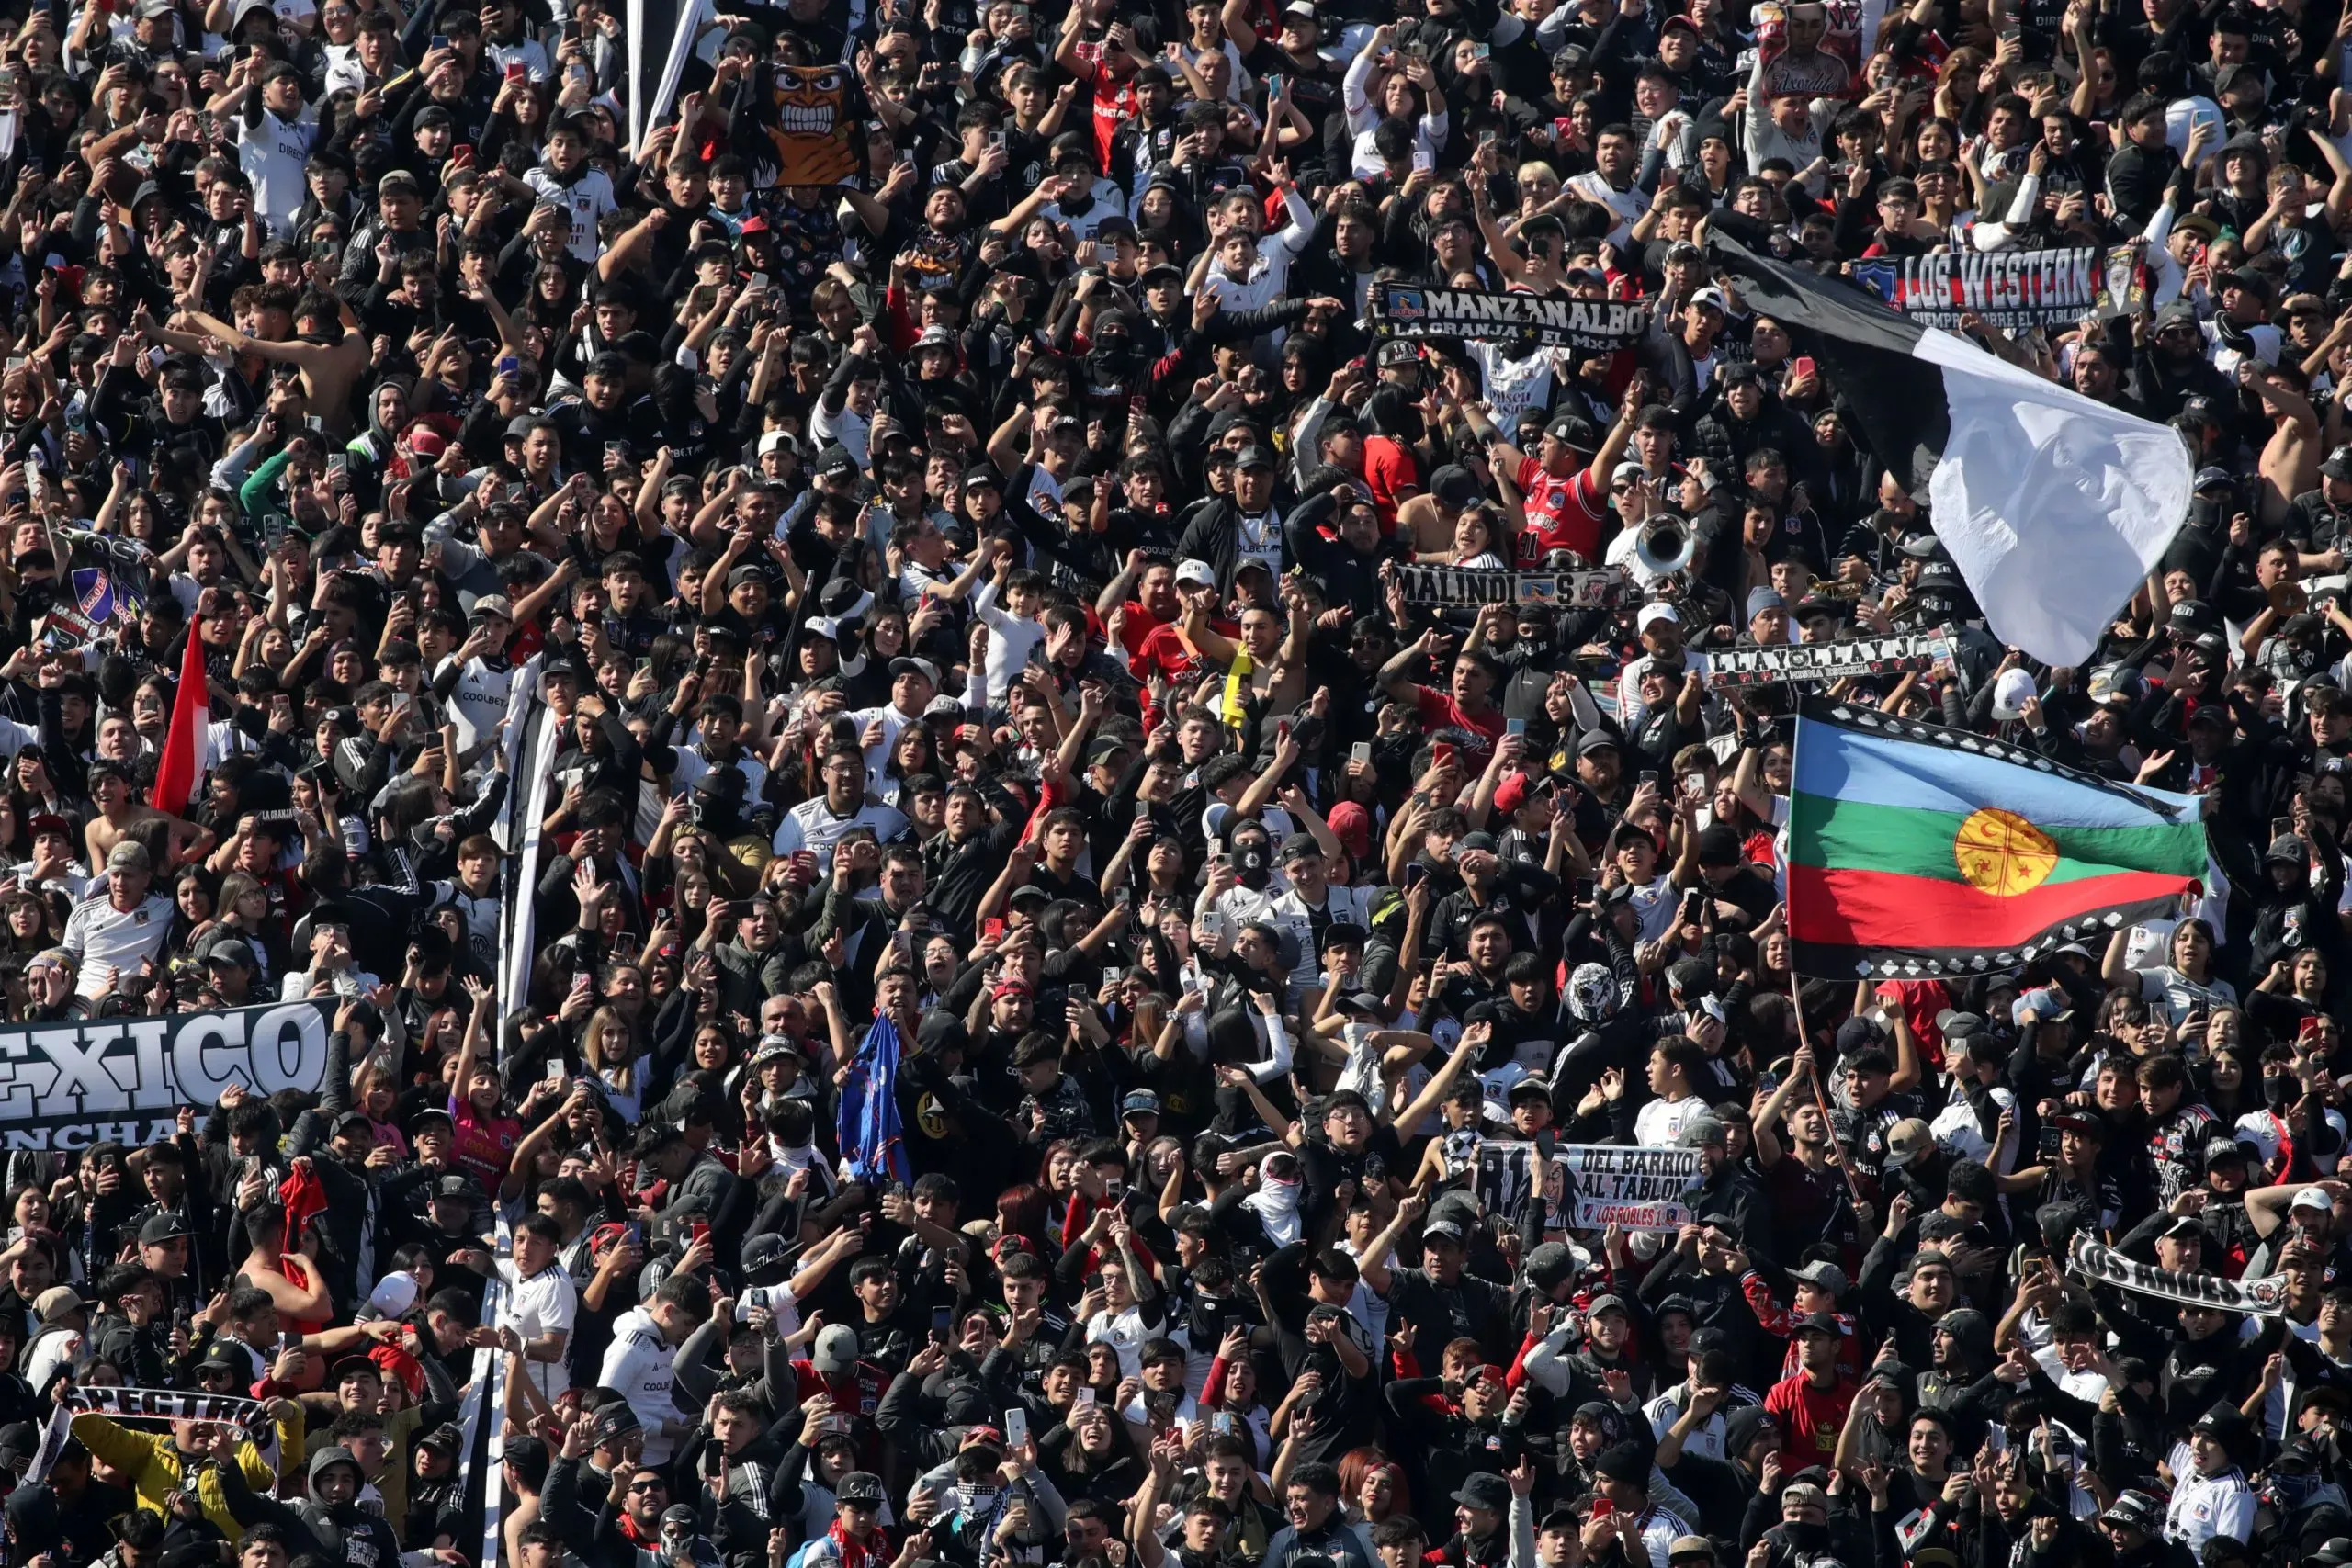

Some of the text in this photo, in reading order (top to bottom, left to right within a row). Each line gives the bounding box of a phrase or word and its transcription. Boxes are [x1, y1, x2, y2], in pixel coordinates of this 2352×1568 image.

[1905, 246, 2096, 310] LOS WESTERN
[1425, 290, 1644, 336] MANZANALBO
[1911, 311, 1962, 329] SIEMPR
[1981, 311, 2015, 329] OBRE
[2018, 310, 2032, 325] EL
[1394, 322, 1423, 337] LA
[1429, 321, 1519, 341] GRANJA
[1542, 328, 1565, 346] EL
[262, 808, 294, 820] LA GRANJA
[0, 1117, 198, 1159] NCHA
[1581, 1148, 1616, 1174] DEL
[1622, 1149, 1694, 1177] BARRIO
[1582, 1175, 1688, 1201] AL TABLON
[1596, 1205, 1617, 1223] LOS
[1618, 1206, 1654, 1225] ROBLES
[2134, 1261, 2242, 1307] ANDES
